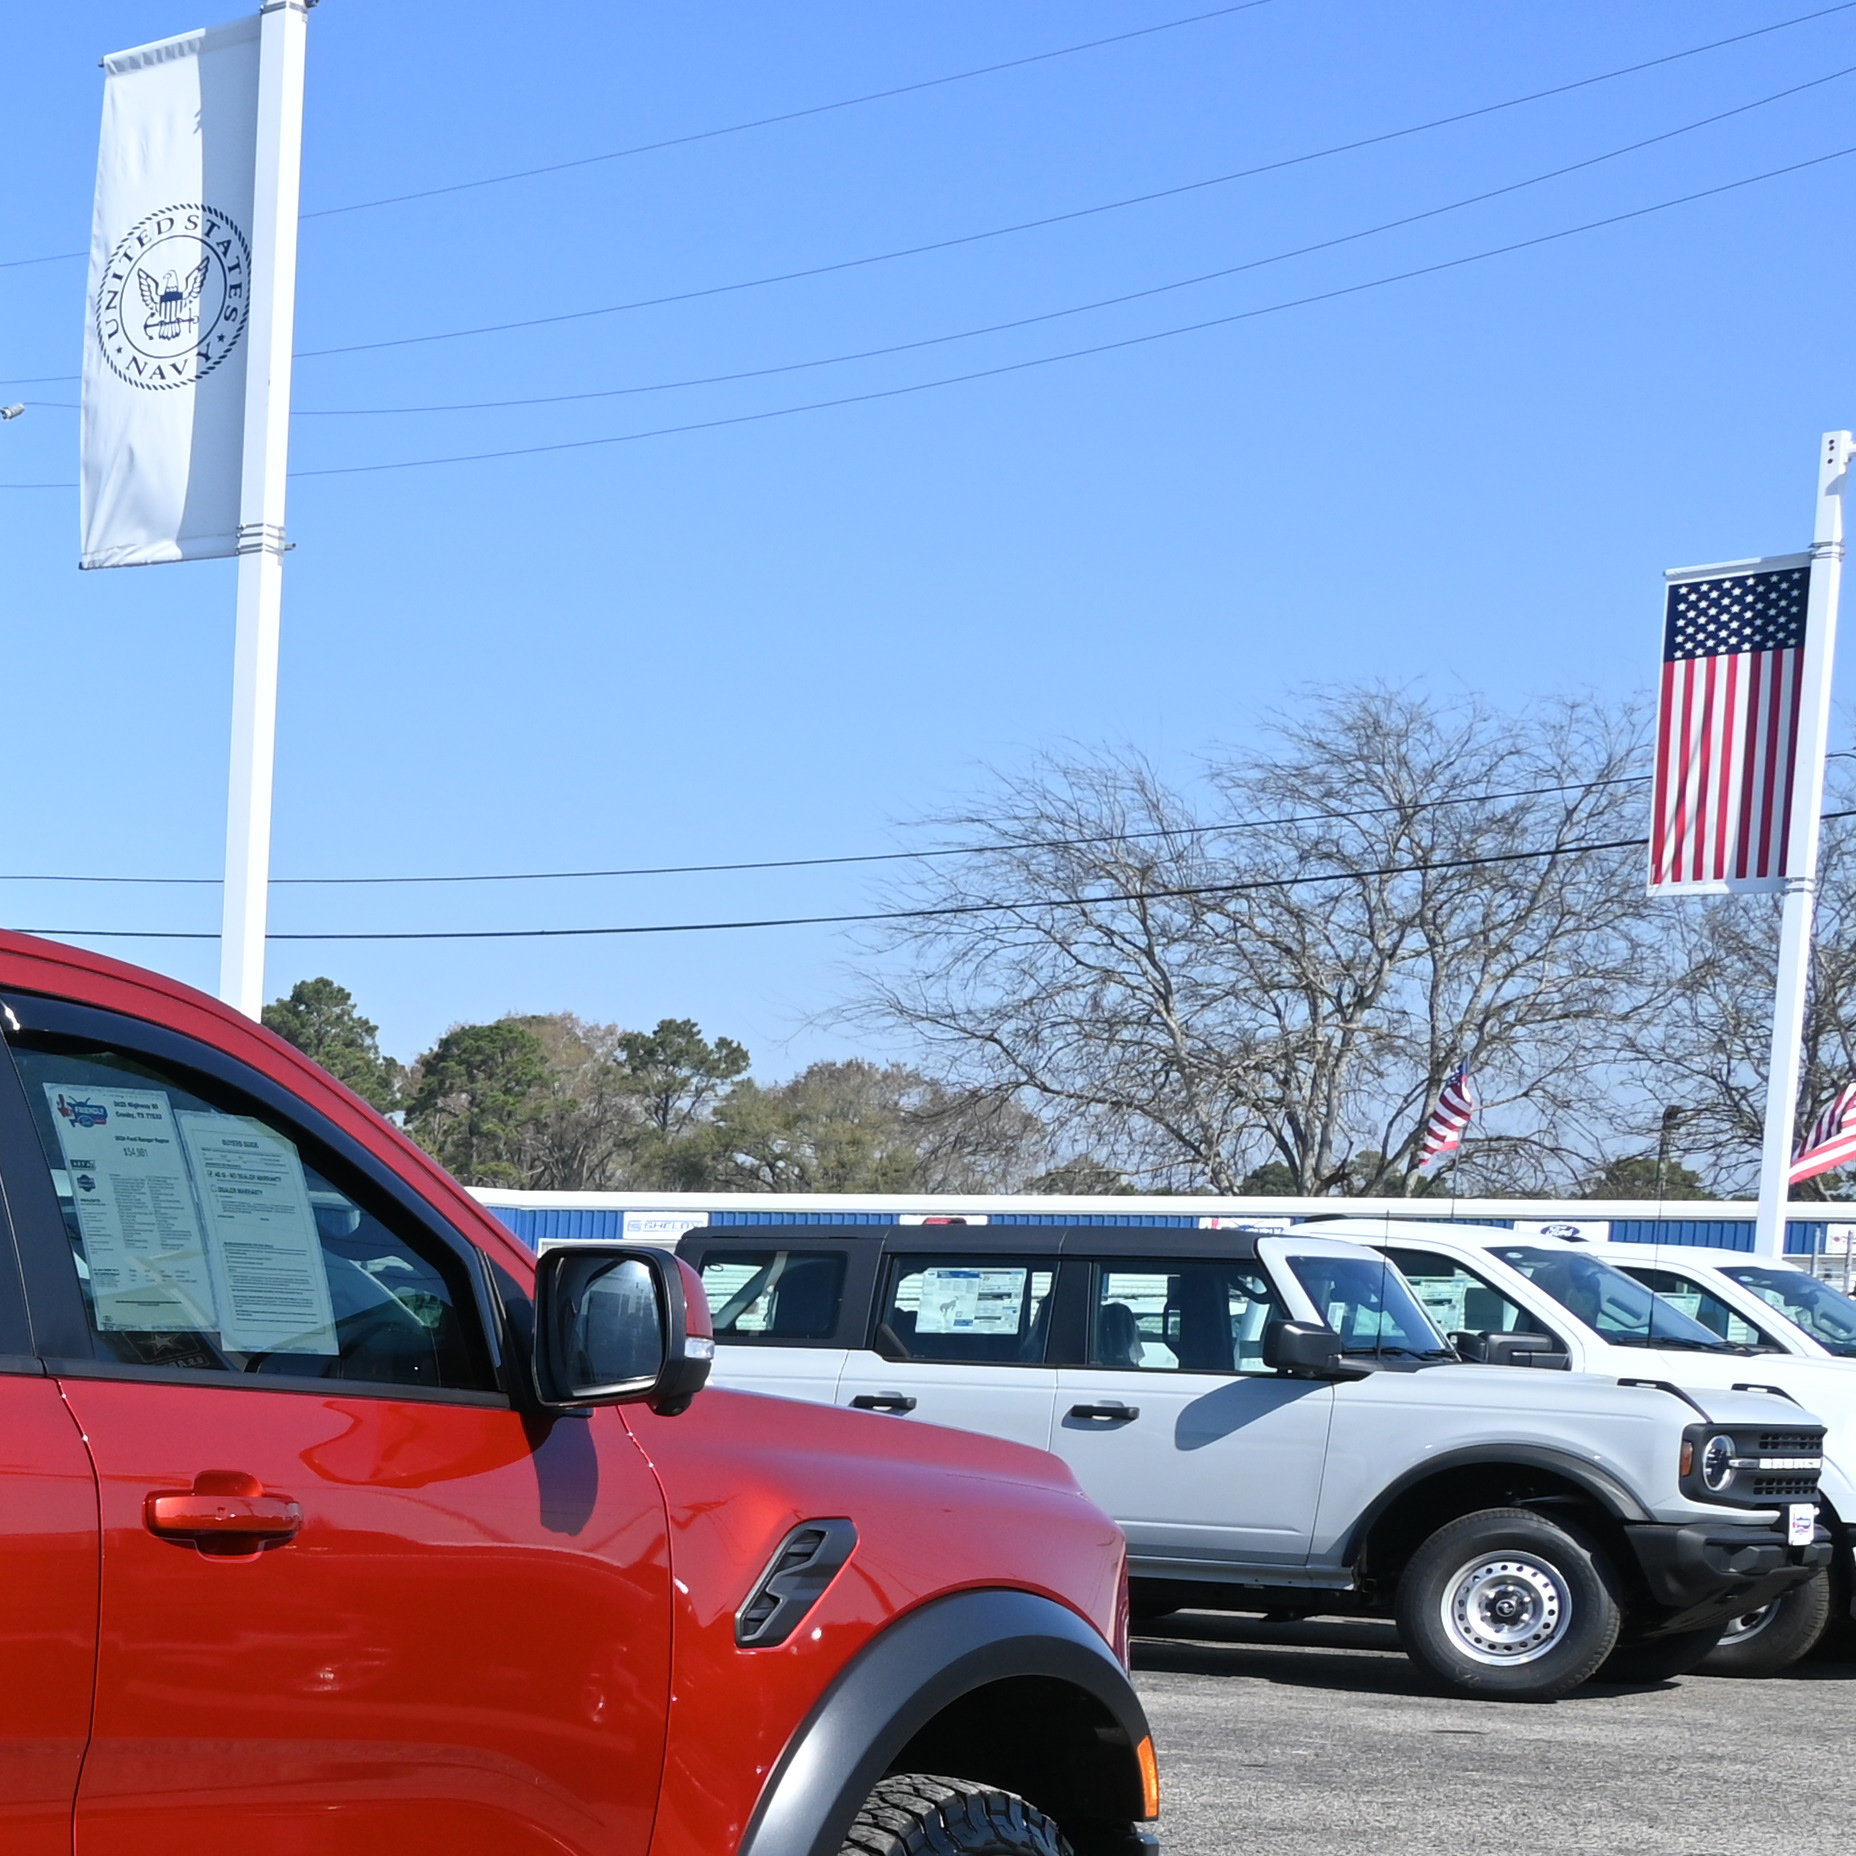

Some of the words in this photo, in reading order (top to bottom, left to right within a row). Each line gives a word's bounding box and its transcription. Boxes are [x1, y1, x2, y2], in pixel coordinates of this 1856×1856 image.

[104, 216, 175, 340] UNITED
[183, 213, 243, 323] STATES
[125, 341, 212, 381] NAVY
